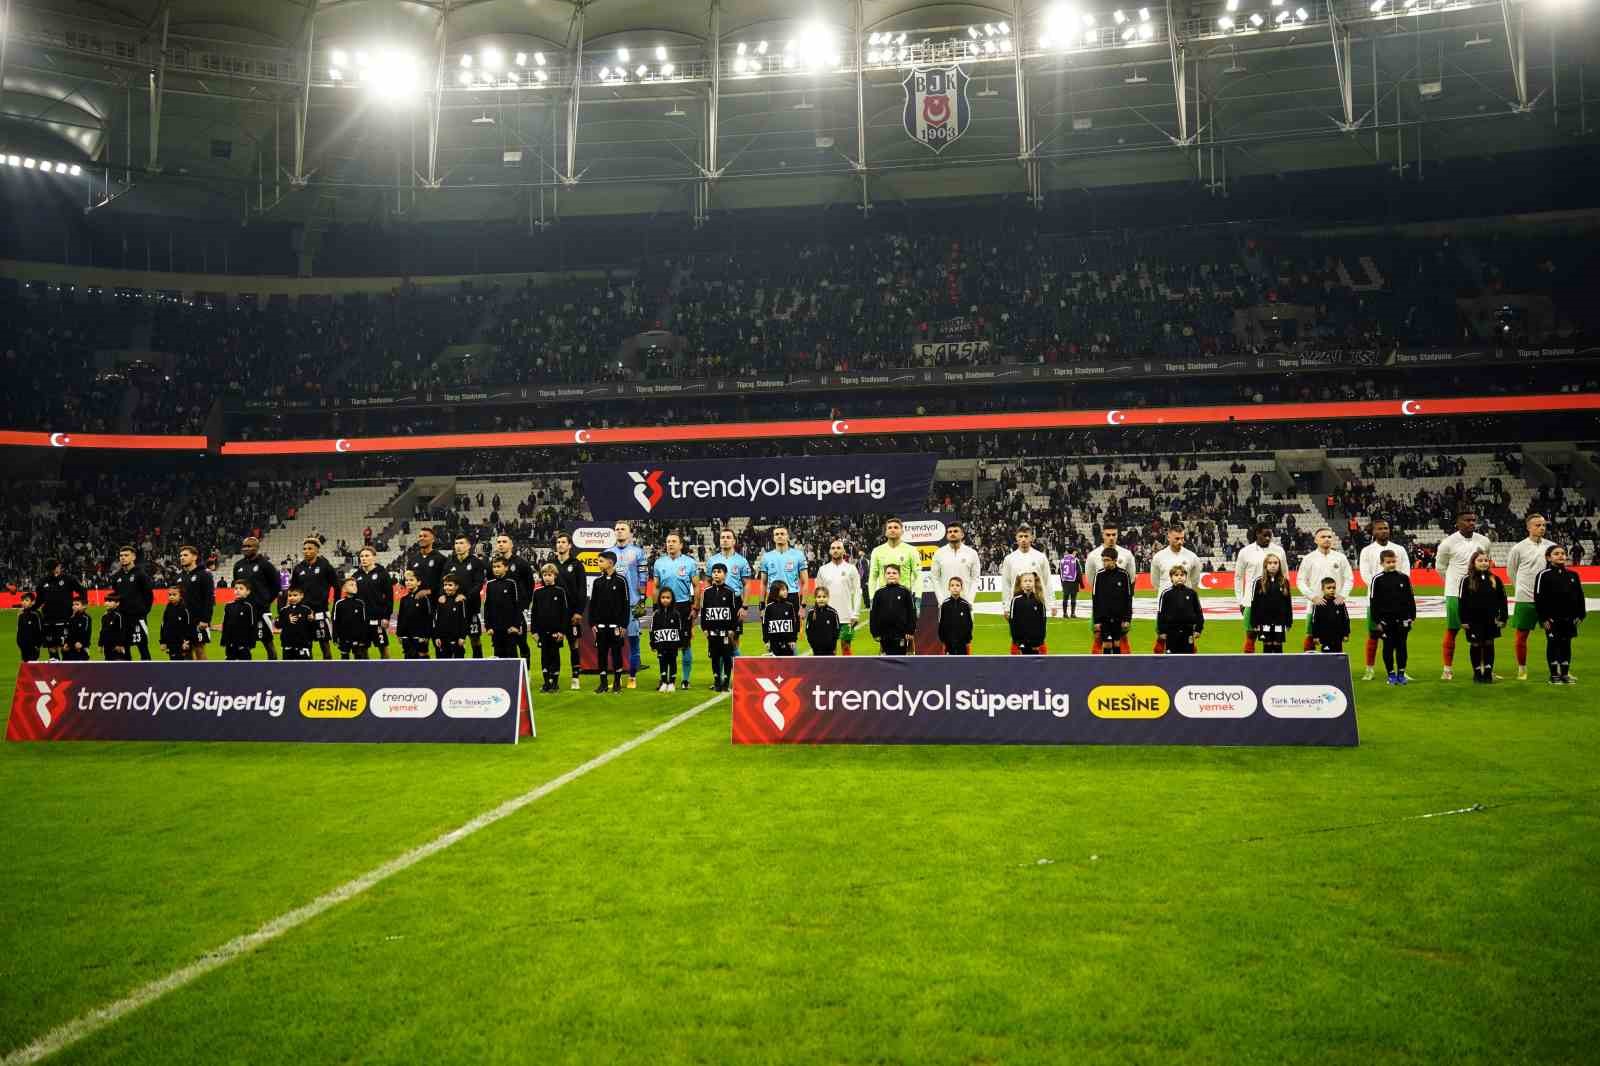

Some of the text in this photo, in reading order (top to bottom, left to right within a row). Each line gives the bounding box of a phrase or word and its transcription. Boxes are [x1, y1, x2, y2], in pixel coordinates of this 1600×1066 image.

[915, 73, 956, 93] BJK
[921, 128, 957, 140] 1903
[668, 473, 886, 502] trendyol SüperLig
[580, 529, 611, 539] trendyol
[705, 607, 732, 620] SAYGI
[767, 619, 794, 633] SAYGI
[132, 632, 142, 643] 23
[653, 629, 681, 641] SAYGI
[77, 687, 286, 717] trendyol SüperLig
[382, 693, 428, 704] trendyol
[812, 684, 1070, 718] trendyol SüperLig
[1188, 690, 1244, 703] trendyol
[388, 704, 419, 713] yemek
[1199, 703, 1235, 713] yemek
